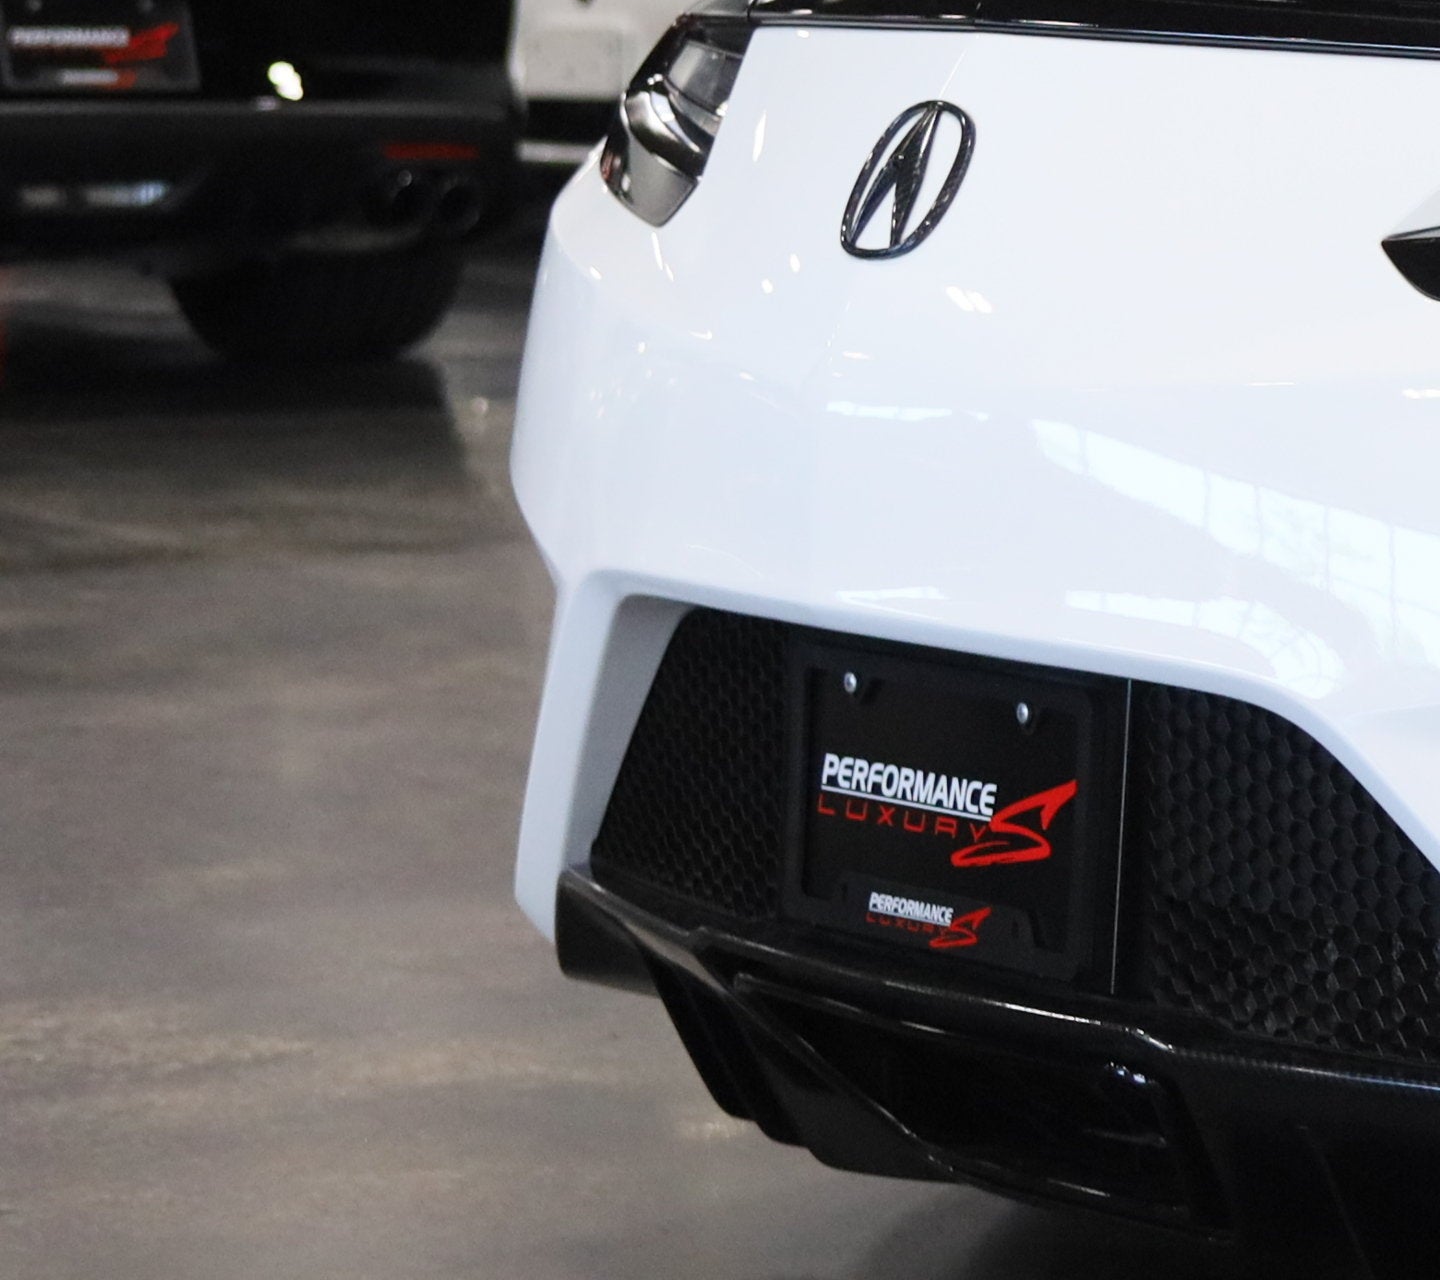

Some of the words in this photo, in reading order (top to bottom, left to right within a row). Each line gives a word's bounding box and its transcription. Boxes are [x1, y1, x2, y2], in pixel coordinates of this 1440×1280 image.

[821, 752, 998, 817] PERFORMANCE
[817, 793, 988, 843] LUXURY
[868, 891, 954, 926] PERFORMANCE
